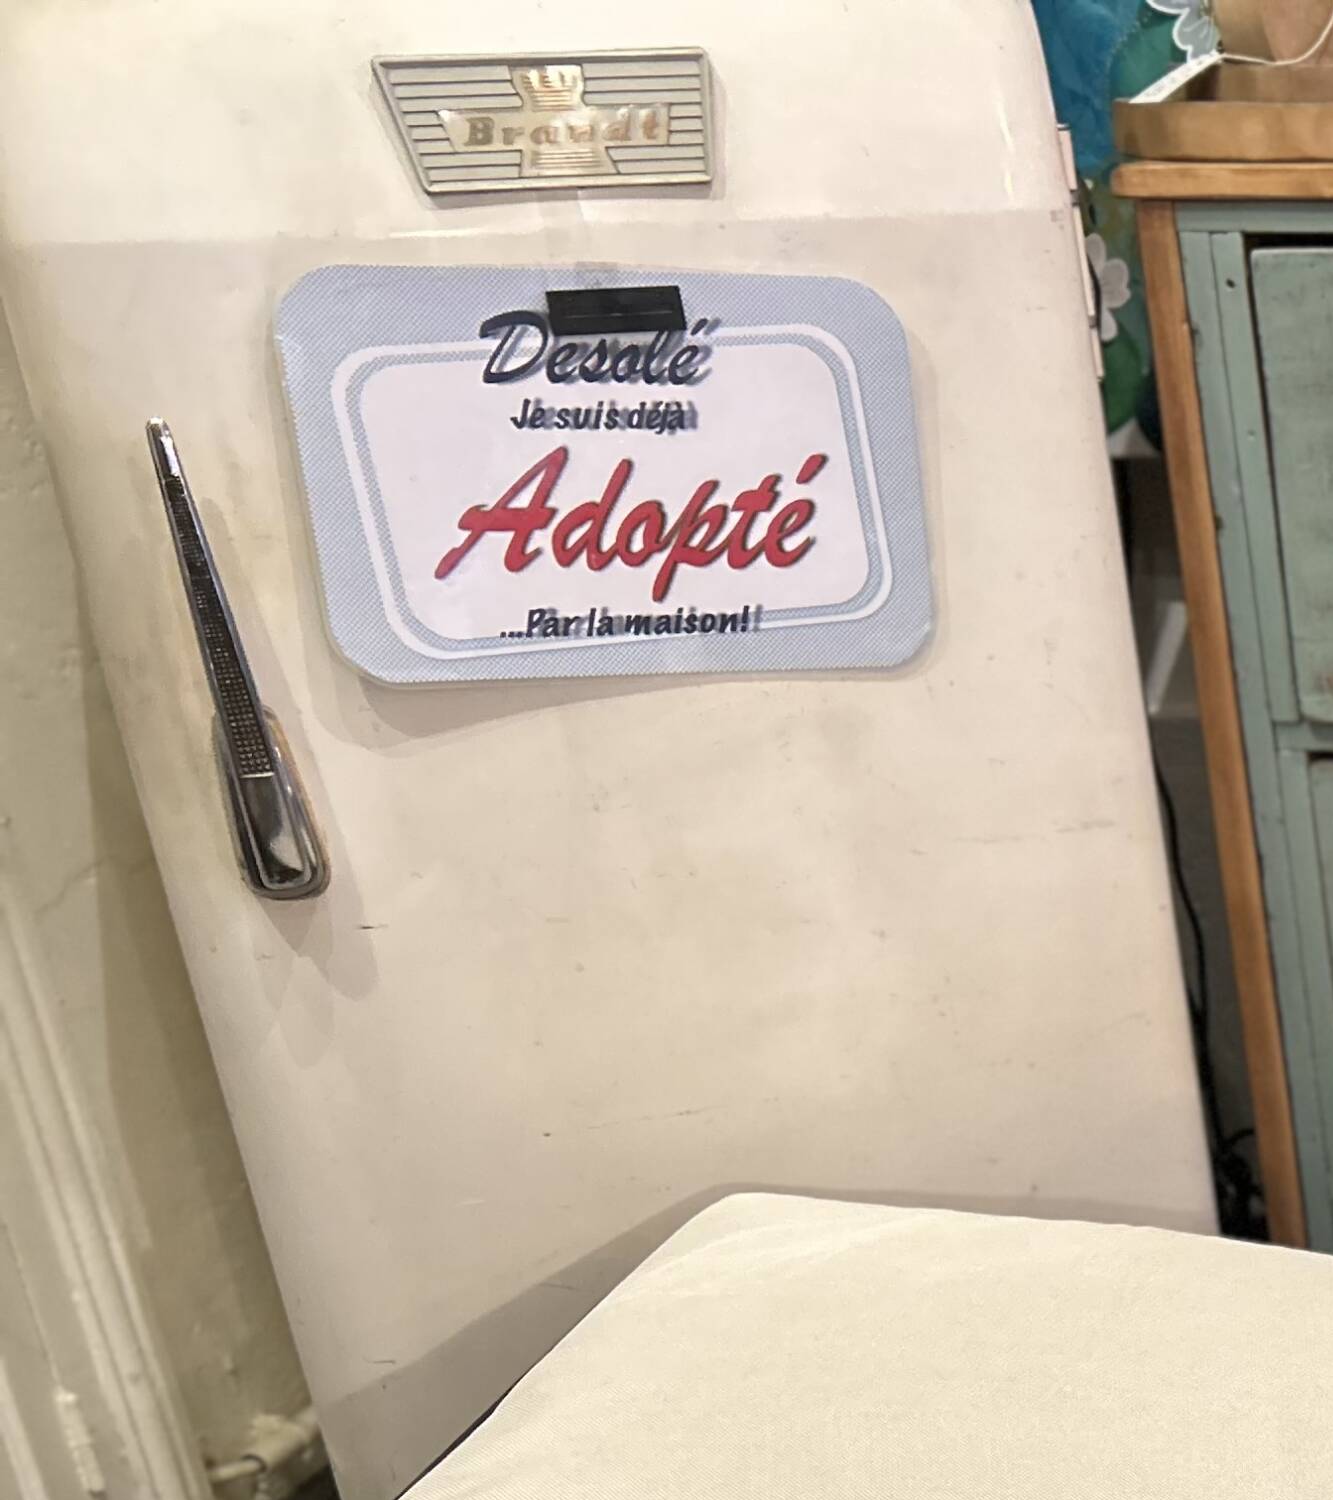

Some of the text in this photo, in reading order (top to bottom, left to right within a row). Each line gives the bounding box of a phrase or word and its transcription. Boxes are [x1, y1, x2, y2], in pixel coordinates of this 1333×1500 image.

[464, 106, 661, 147] Brandt
[510, 398, 686, 435] Je suis déjà
[434, 445, 829, 602] Adopté
[587, 607, 614, 637] la
[624, 605, 750, 635] maison!
